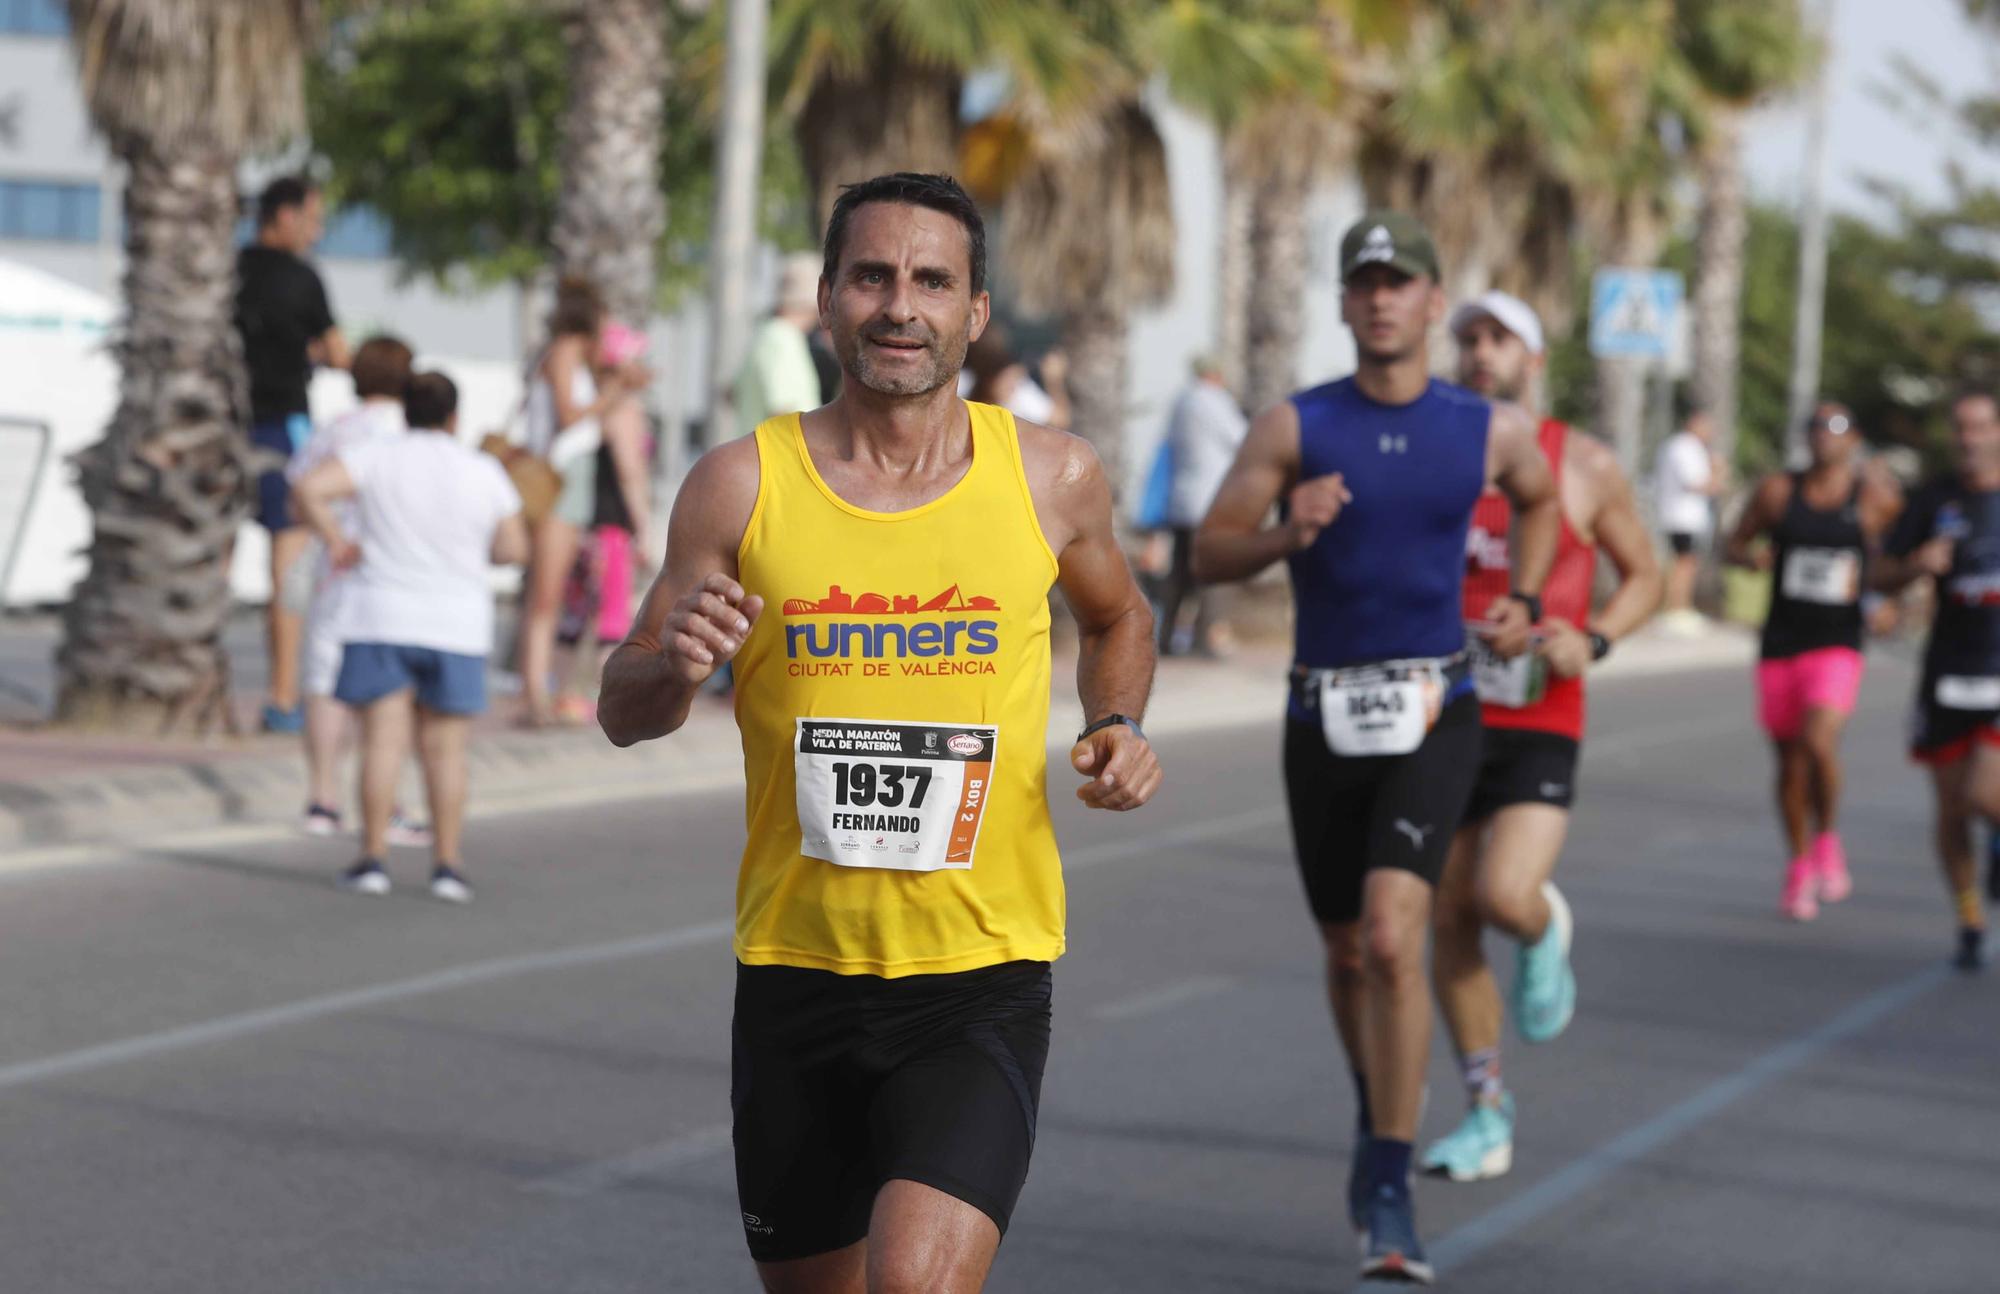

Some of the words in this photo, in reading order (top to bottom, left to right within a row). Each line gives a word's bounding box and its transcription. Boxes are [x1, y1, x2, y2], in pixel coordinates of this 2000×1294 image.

[785, 620, 998, 658] runners
[788, 663, 853, 677] CIUTAT
[863, 663, 890, 676] DE
[900, 658, 996, 676] VALÈNCIA
[812, 728, 844, 740] MEDIA
[846, 729, 900, 741] MARATÓN
[812, 738, 835, 749] VILA
[839, 740, 852, 750] DE
[855, 741, 903, 752] PATERNA
[952, 740, 980, 750] Serrano
[832, 763, 933, 809] 1937
[965, 779, 983, 808] BOX
[832, 813, 920, 834] FERNANDO
[961, 813, 974, 822] 2
